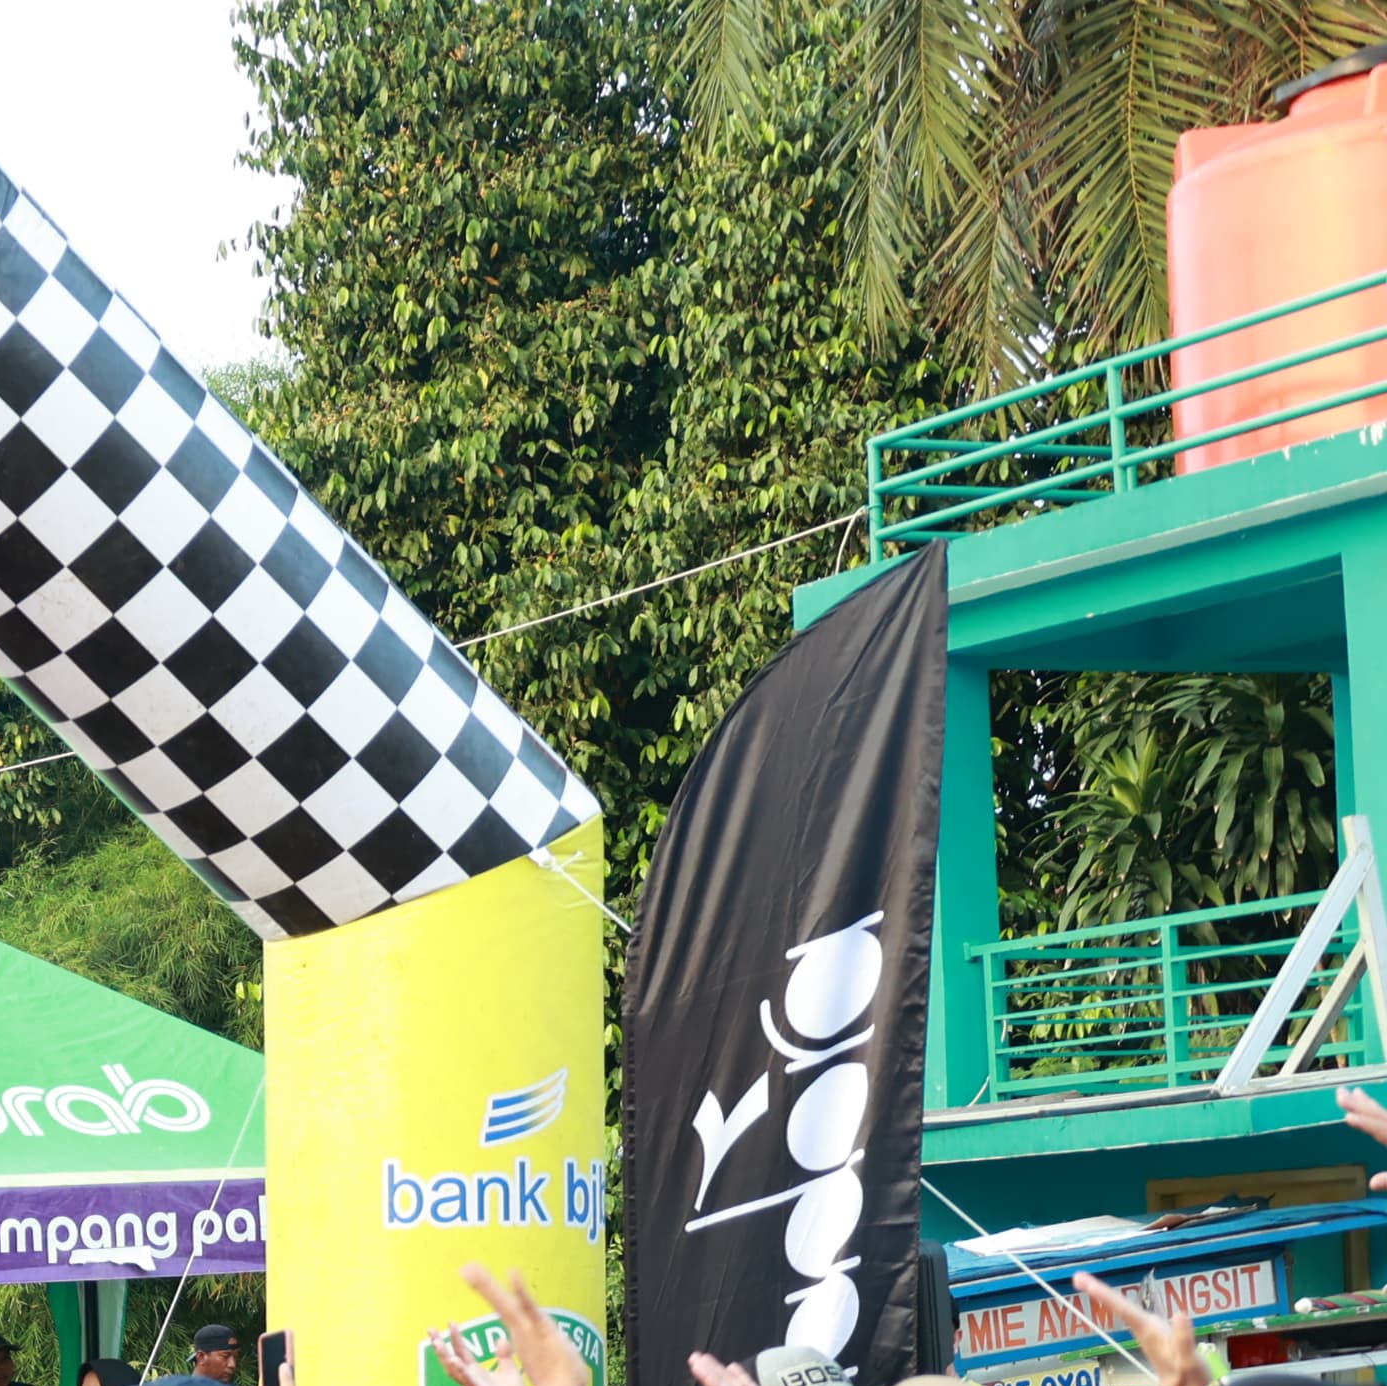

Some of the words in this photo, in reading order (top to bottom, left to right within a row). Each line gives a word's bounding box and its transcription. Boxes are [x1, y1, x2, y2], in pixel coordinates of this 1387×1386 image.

[385, 1160, 548, 1224] bank
[967, 1304, 1027, 1354] MIE
[1037, 1290, 1115, 1342] AYAM
